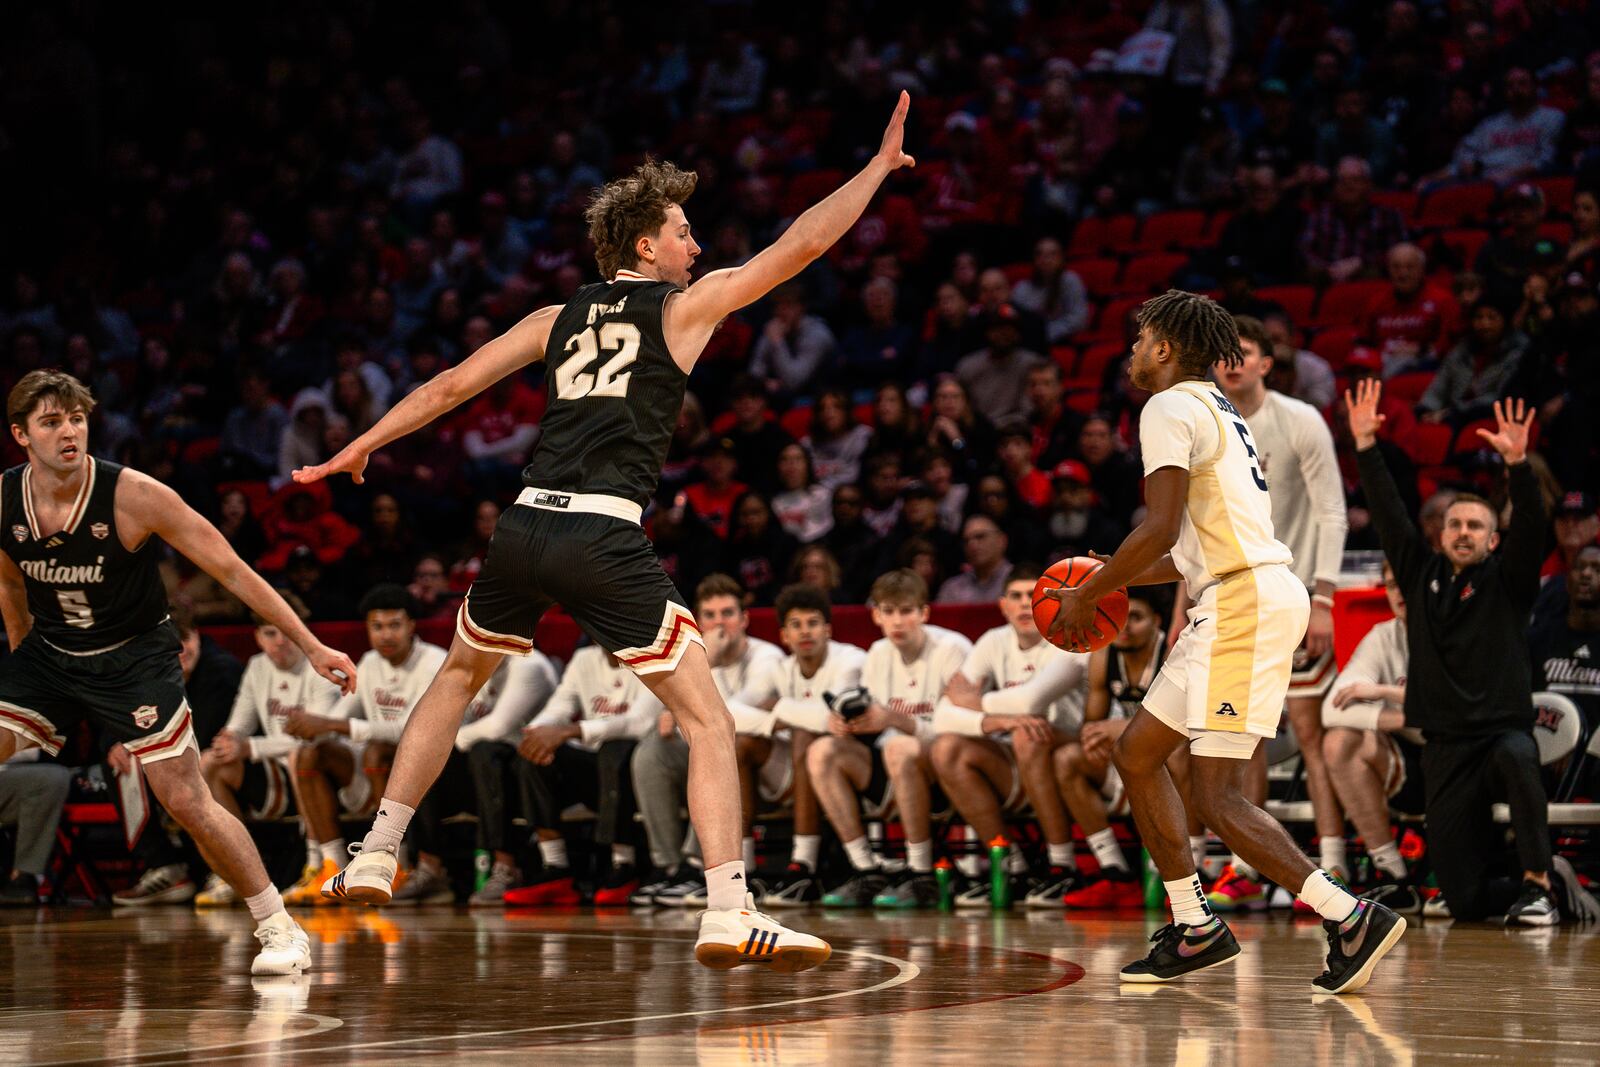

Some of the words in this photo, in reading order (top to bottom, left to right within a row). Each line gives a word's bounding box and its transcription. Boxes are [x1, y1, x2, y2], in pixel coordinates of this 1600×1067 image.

[555, 322, 641, 400] 22
[19, 555, 105, 584] Miami
[54, 588, 95, 629] 5
[1215, 702, 1239, 717] A
